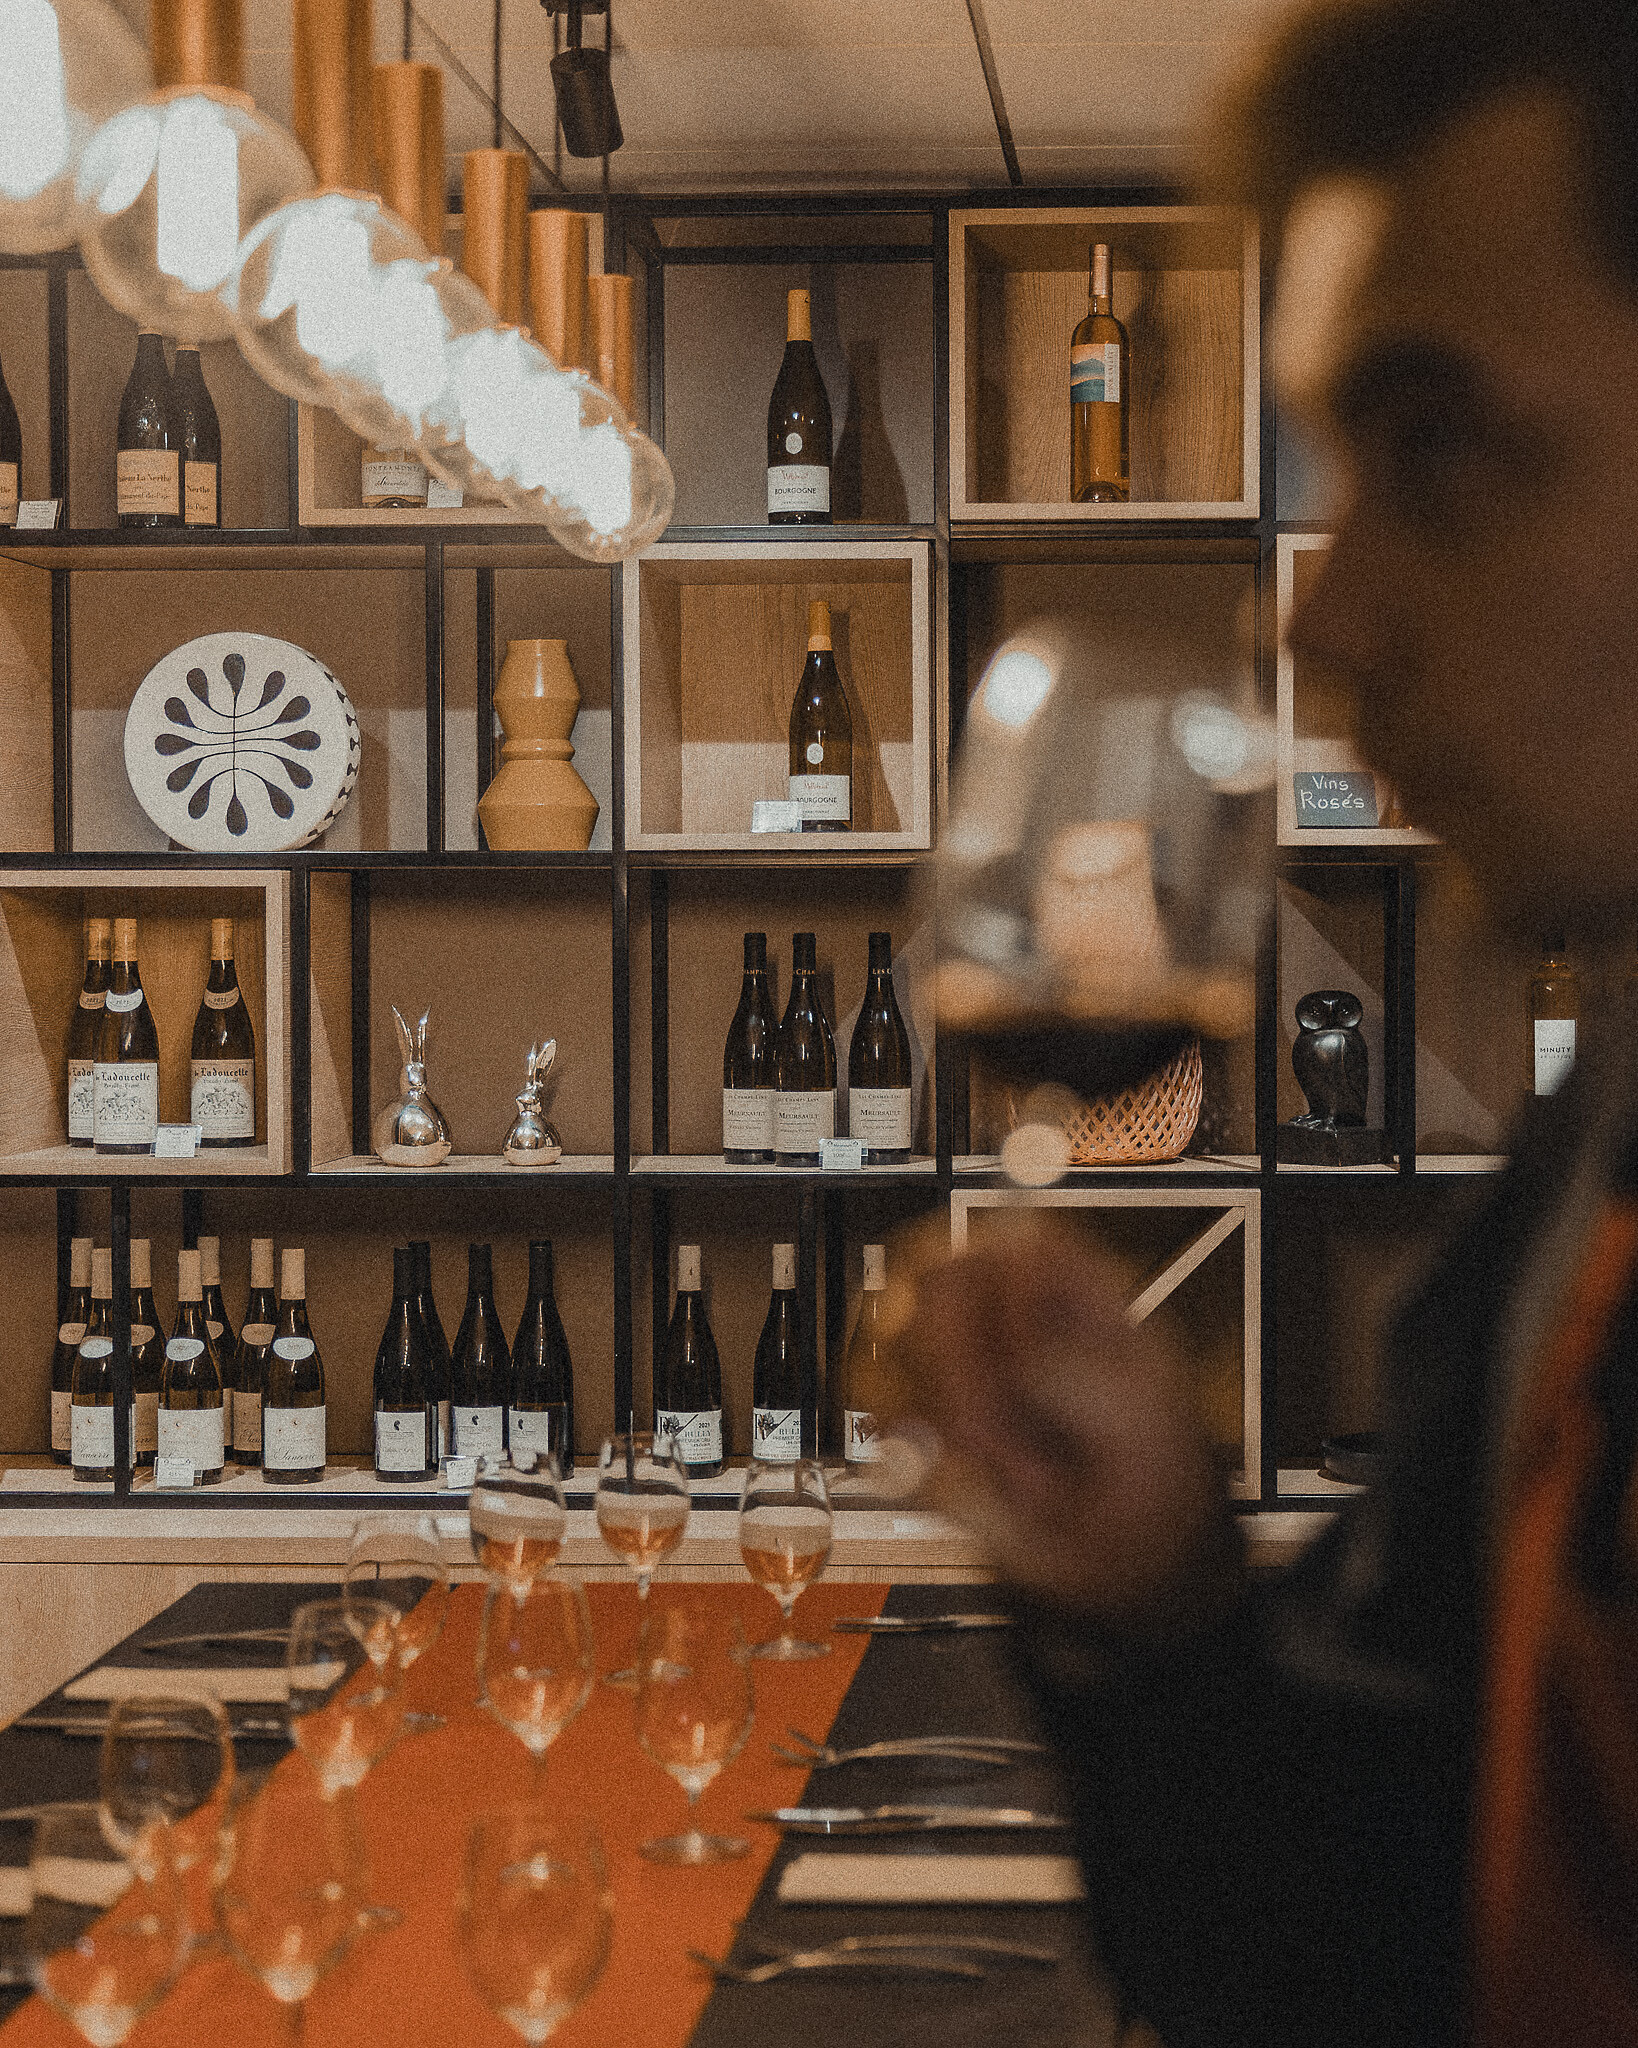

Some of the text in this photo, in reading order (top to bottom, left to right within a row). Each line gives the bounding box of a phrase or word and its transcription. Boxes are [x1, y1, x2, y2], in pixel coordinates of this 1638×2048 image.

[774, 487, 817, 495] BOURGOGNE
[1311, 775, 1349, 791] Vins
[796, 796, 838, 804] BOURGOGNE
[1300, 788, 1365, 811] Rosés
[101, 1071, 151, 1082] Ladoucette
[200, 1067, 249, 1077] Ladoucette
[778, 1112, 820, 1120] MEURSAULT
[273, 1446, 316, 1461] Sancerre
